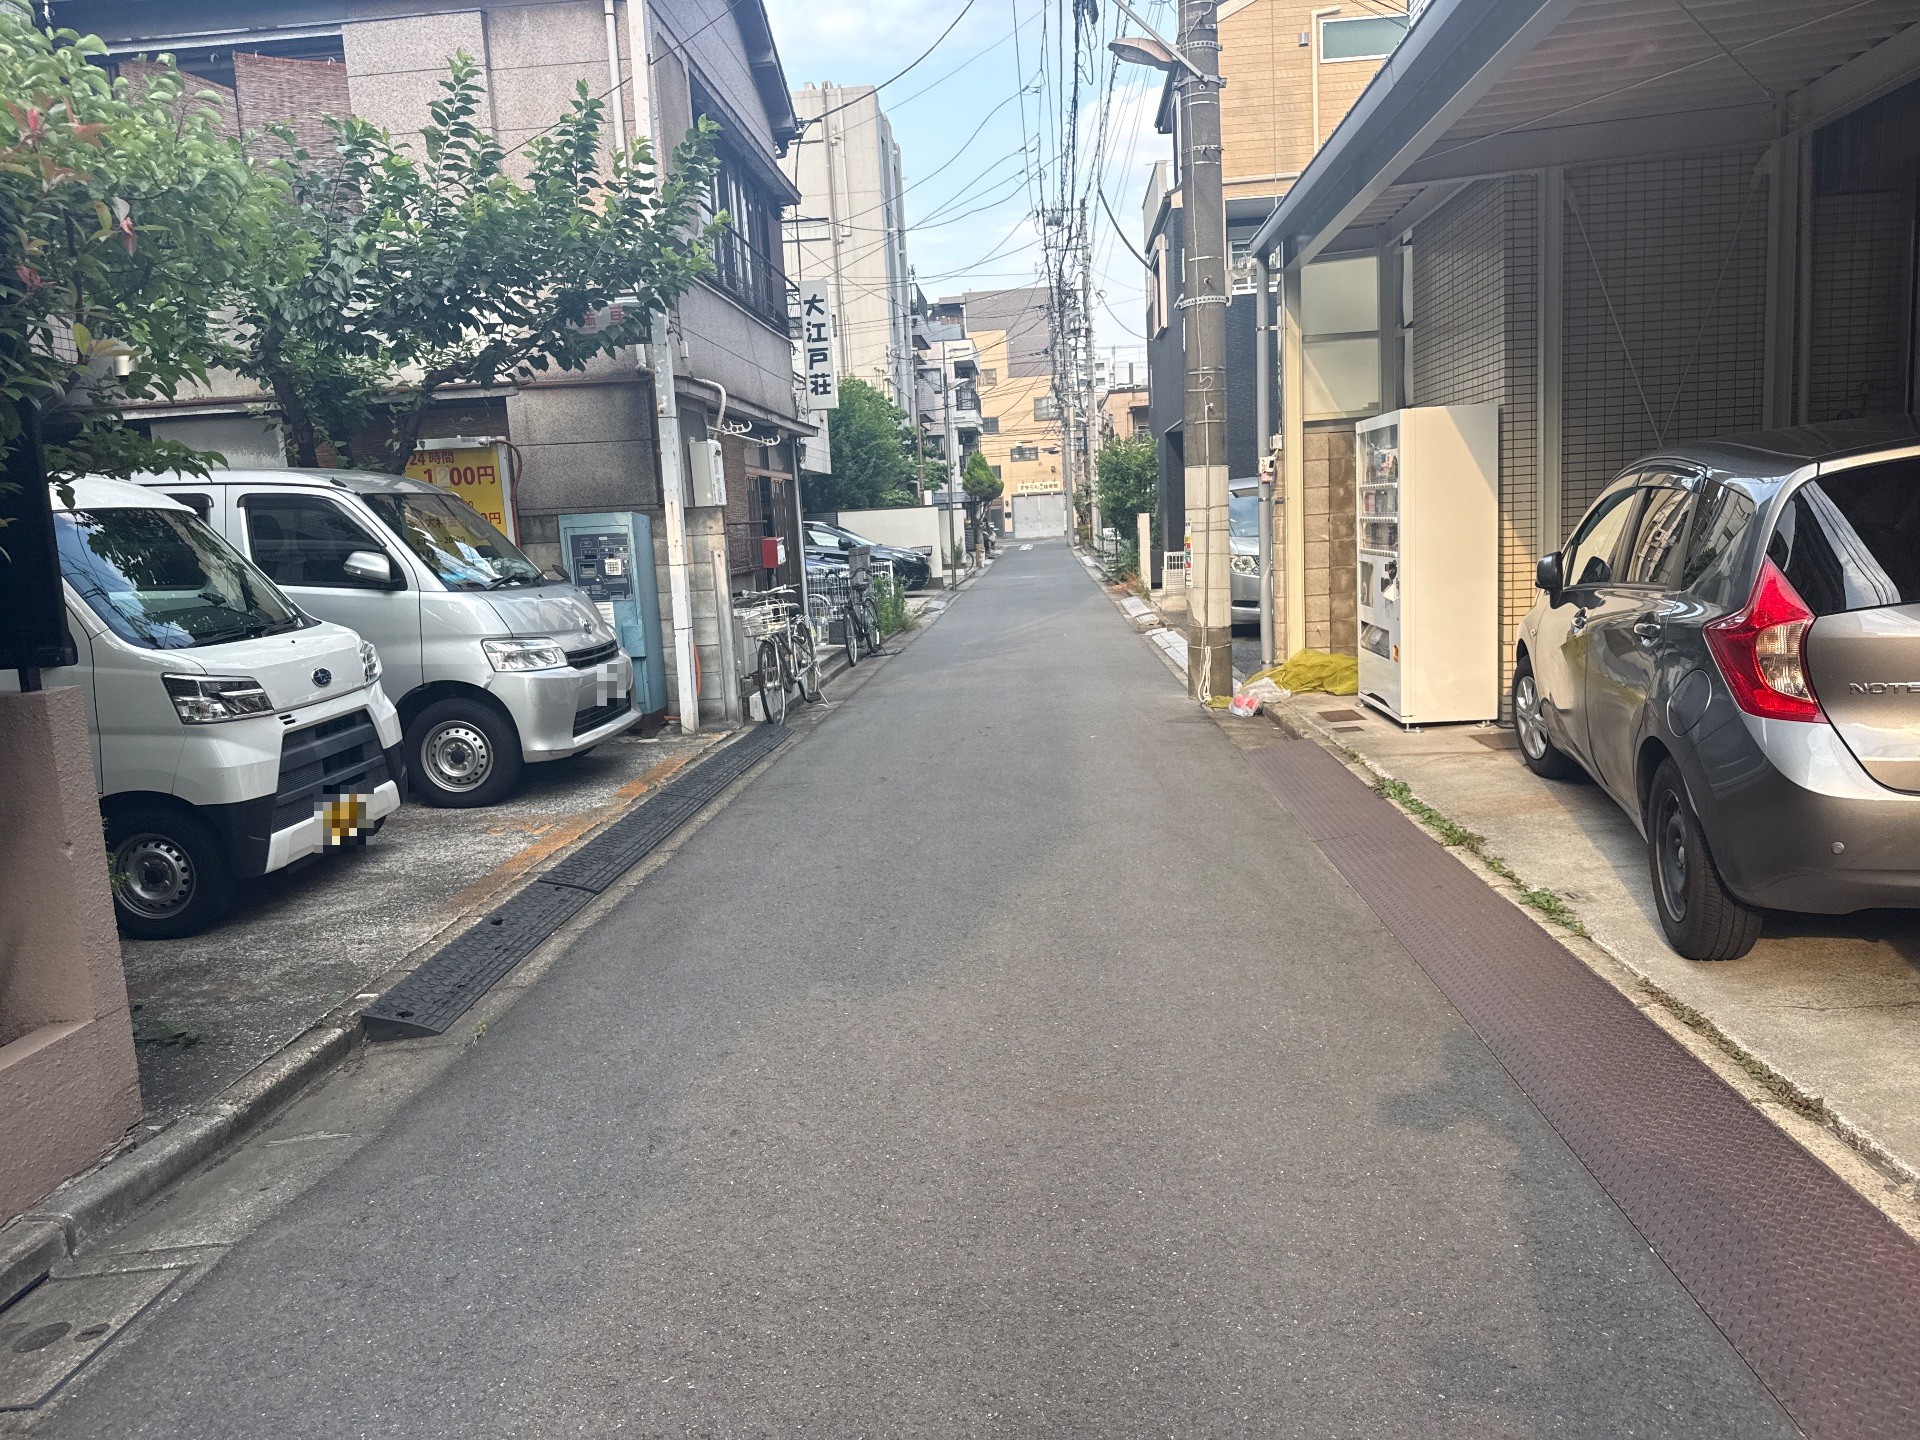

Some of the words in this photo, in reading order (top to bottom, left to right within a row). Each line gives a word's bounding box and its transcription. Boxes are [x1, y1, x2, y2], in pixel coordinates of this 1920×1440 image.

[803, 294, 831, 396] 大江戸荘
[1849, 682, 1920, 694] NOTE
